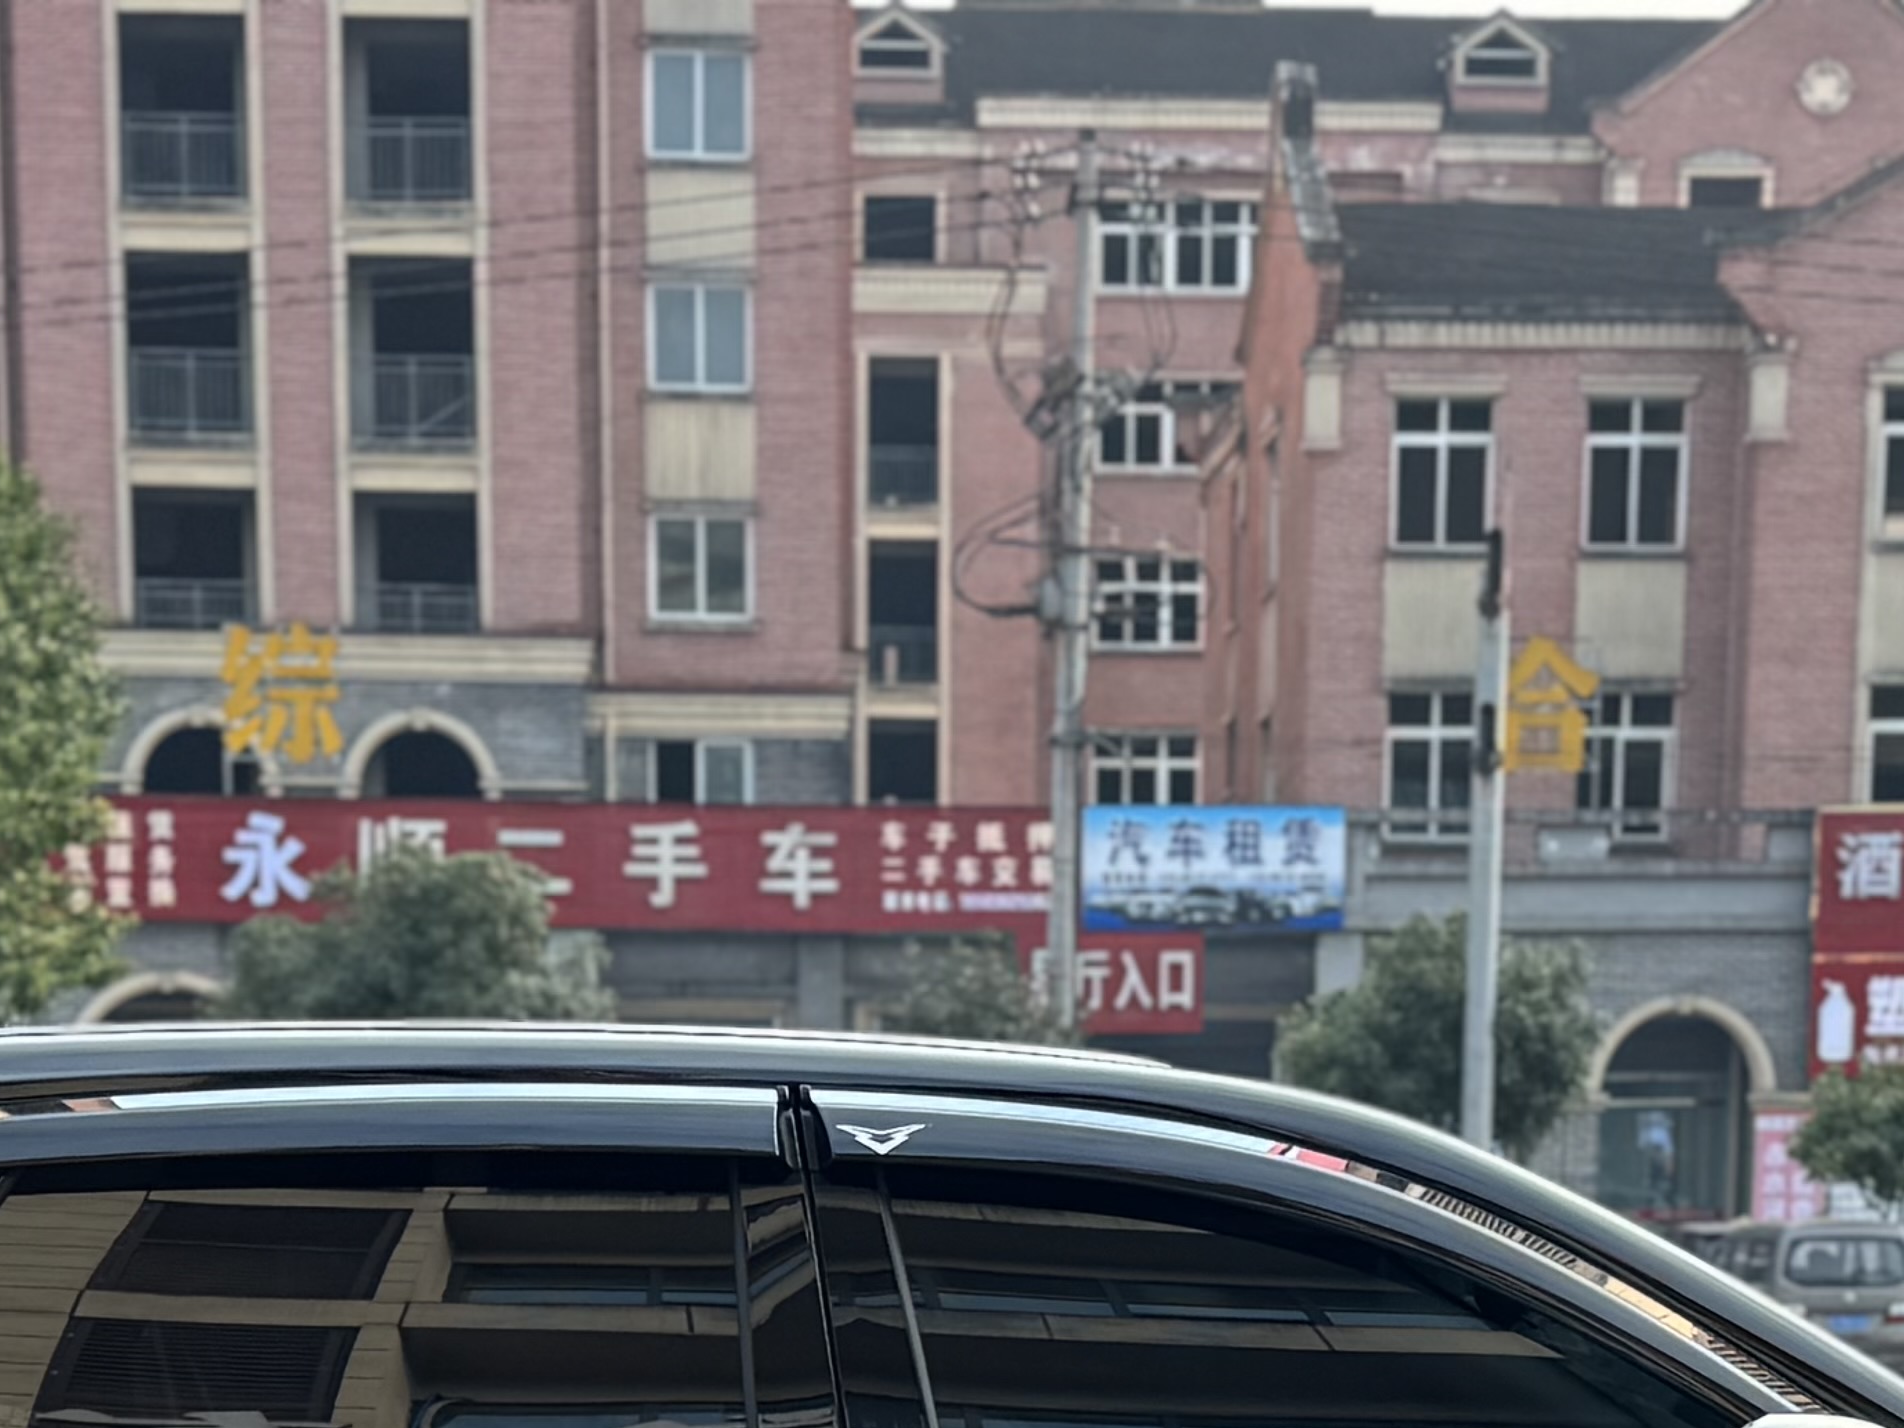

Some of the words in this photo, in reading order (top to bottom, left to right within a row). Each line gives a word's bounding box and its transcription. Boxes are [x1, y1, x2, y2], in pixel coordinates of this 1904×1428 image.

[222, 621, 344, 763] 综
[1107, 816, 1320, 869] 汽车租赁
